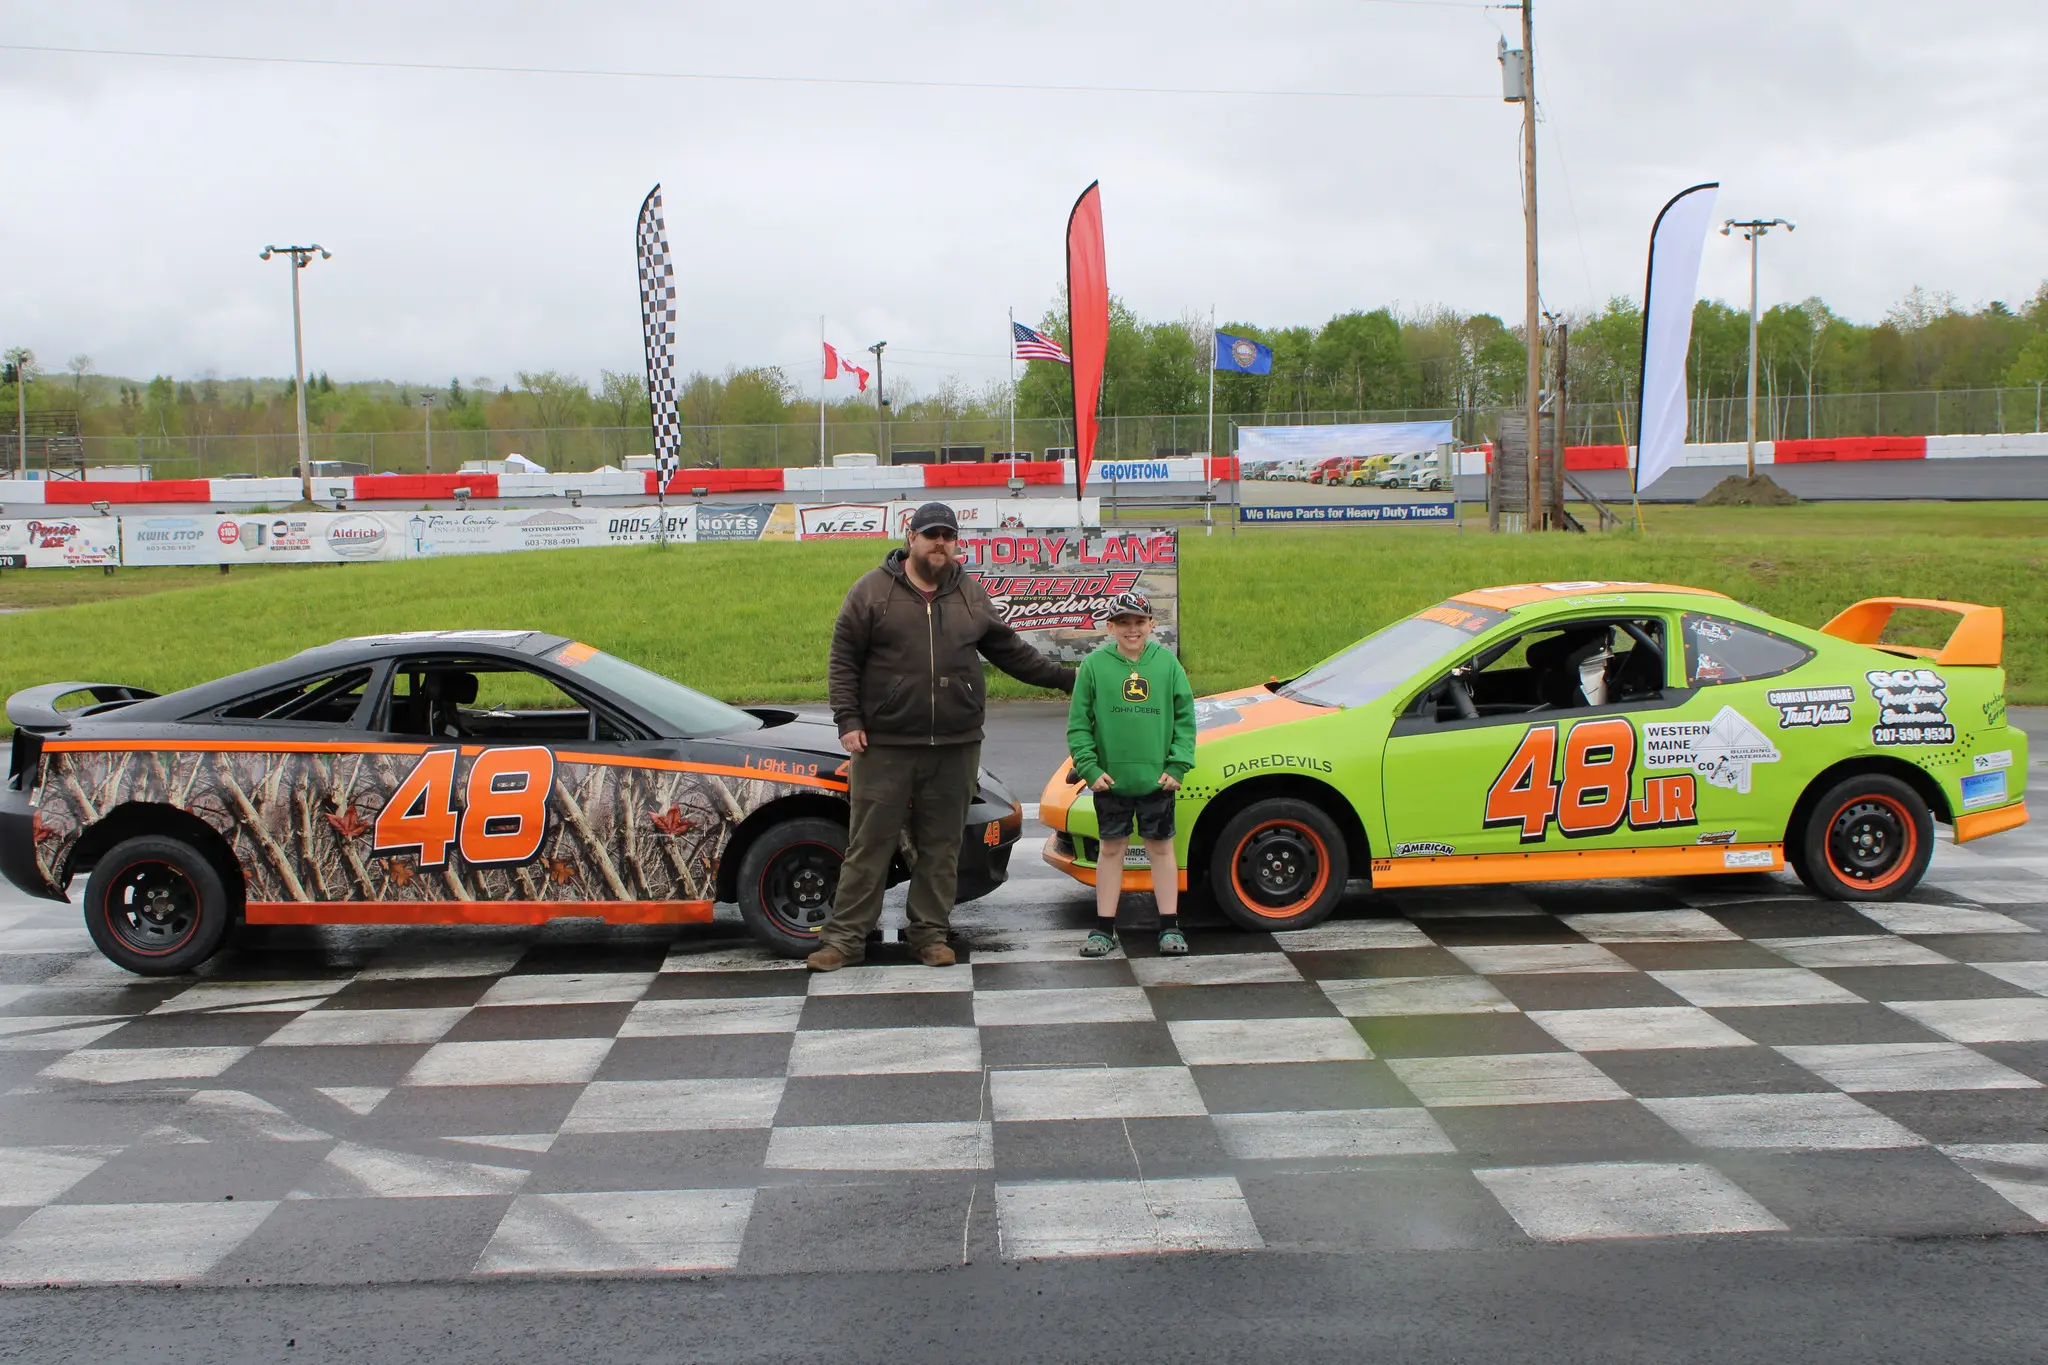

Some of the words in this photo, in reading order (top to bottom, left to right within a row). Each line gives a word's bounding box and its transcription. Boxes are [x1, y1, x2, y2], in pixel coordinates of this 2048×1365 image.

[1246, 509, 1264, 519] We
[1266, 508, 1294, 519] Have
[1296, 508, 1325, 519] Parts
[1327, 508, 1343, 518] for
[1347, 507, 1380, 519] Heavy
[1382, 507, 1408, 519] Duty
[1410, 505, 1449, 517] Trucks
[463, 515, 499, 529] Country
[698, 518, 758, 530] NOYES
[220, 527, 237, 537] $100
[332, 529, 378, 538] Aldrich
[521, 525, 585, 533] MOTORSPORTS
[137, 531, 170, 541] KWIK
[172, 530, 205, 541] STOP
[525, 538, 581, 547] 603-788-4991
[1079, 535, 1175, 565] LANE
[1010, 616, 1060, 629] ADVENTURE
[1061, 615, 1085, 625] PARK
[1769, 690, 1807, 705] CORNISH
[1806, 687, 1854, 702] HARDWARE
[1111, 705, 1133, 713] JOHN
[1134, 705, 1161, 715] DEERE
[1648, 725, 1711, 737] WESTERN
[1874, 727, 1952, 742] 207-590-9534
[1648, 739, 1691, 751] MAINE
[1648, 753, 1698, 765] SUPPLY
[1697, 762, 1715, 771] CO
[1484, 717, 1635, 842] 48
[1628, 774, 1697, 829] JR
[372, 745, 555, 867] 48
[983, 820, 1000, 847] 48
[1401, 843, 1454, 855] AMERICAN
